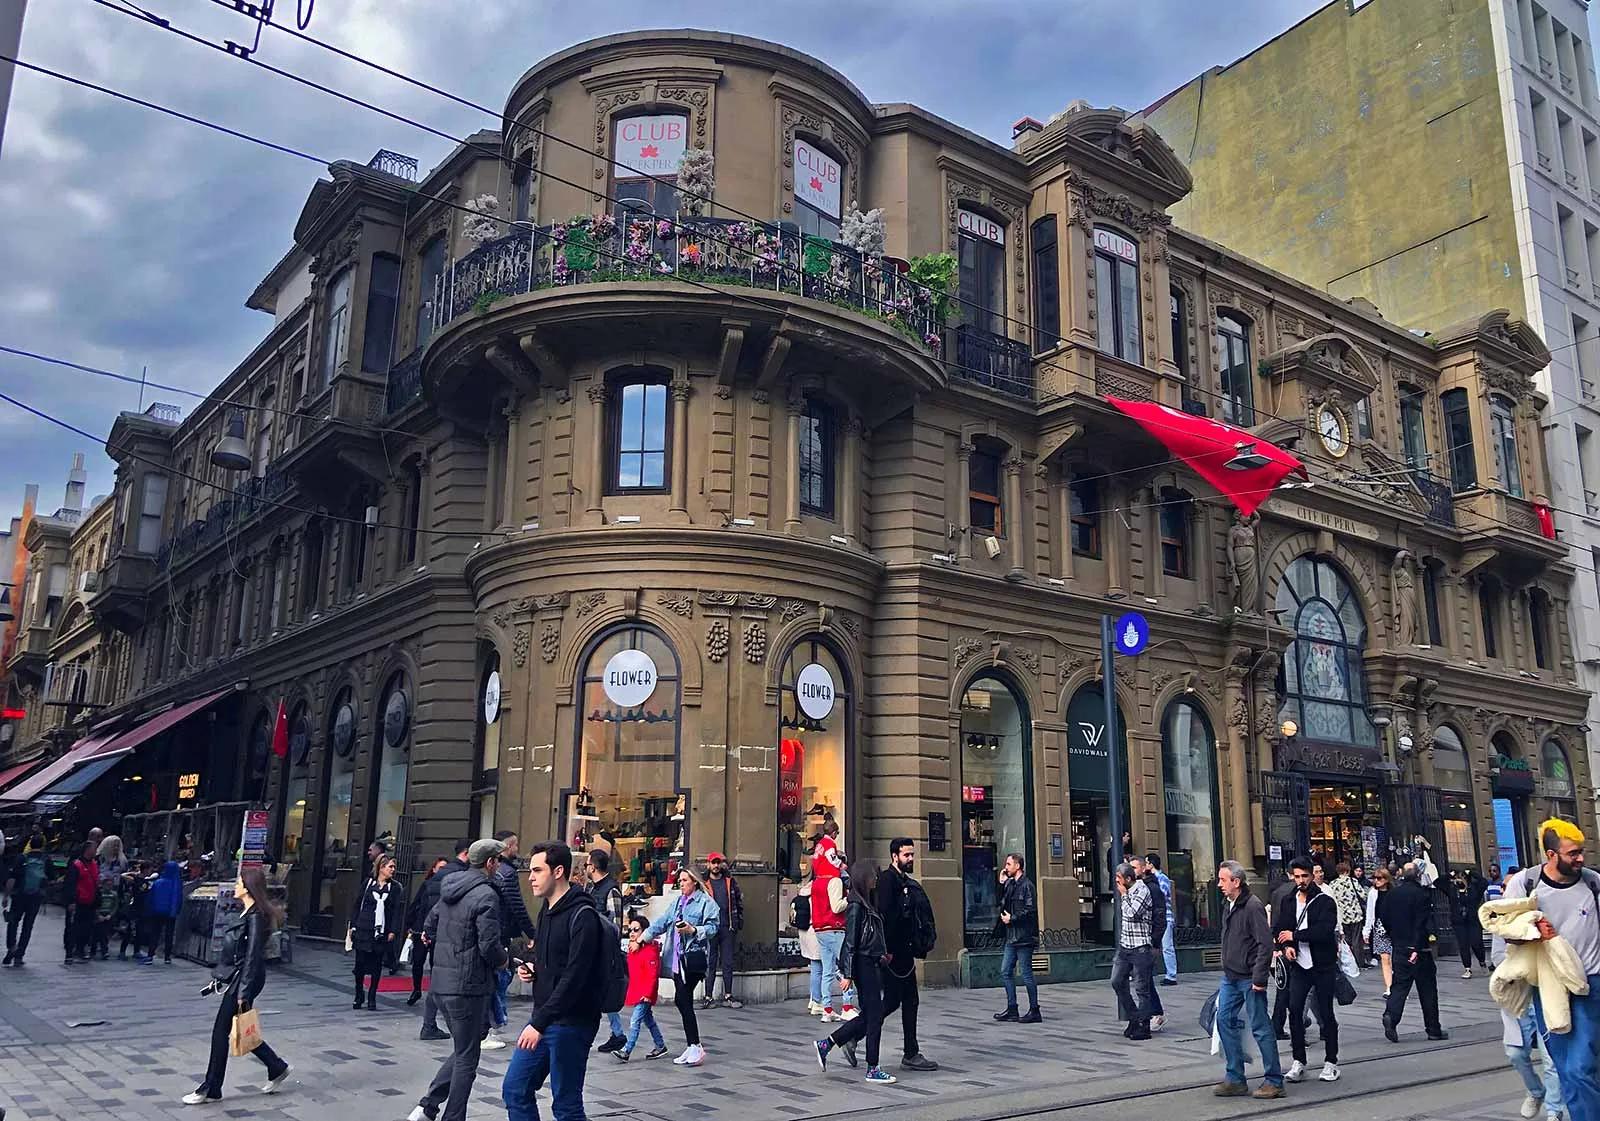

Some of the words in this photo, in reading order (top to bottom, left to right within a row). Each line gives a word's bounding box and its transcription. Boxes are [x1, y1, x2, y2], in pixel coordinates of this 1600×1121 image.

[622, 122, 682, 142] CLUB
[797, 146, 837, 184] CLUB
[959, 212, 998, 241] CLUB
[1098, 232, 1134, 258] CLUB
[609, 670, 651, 687] FLOWER
[802, 682, 831, 701] FLOWER
